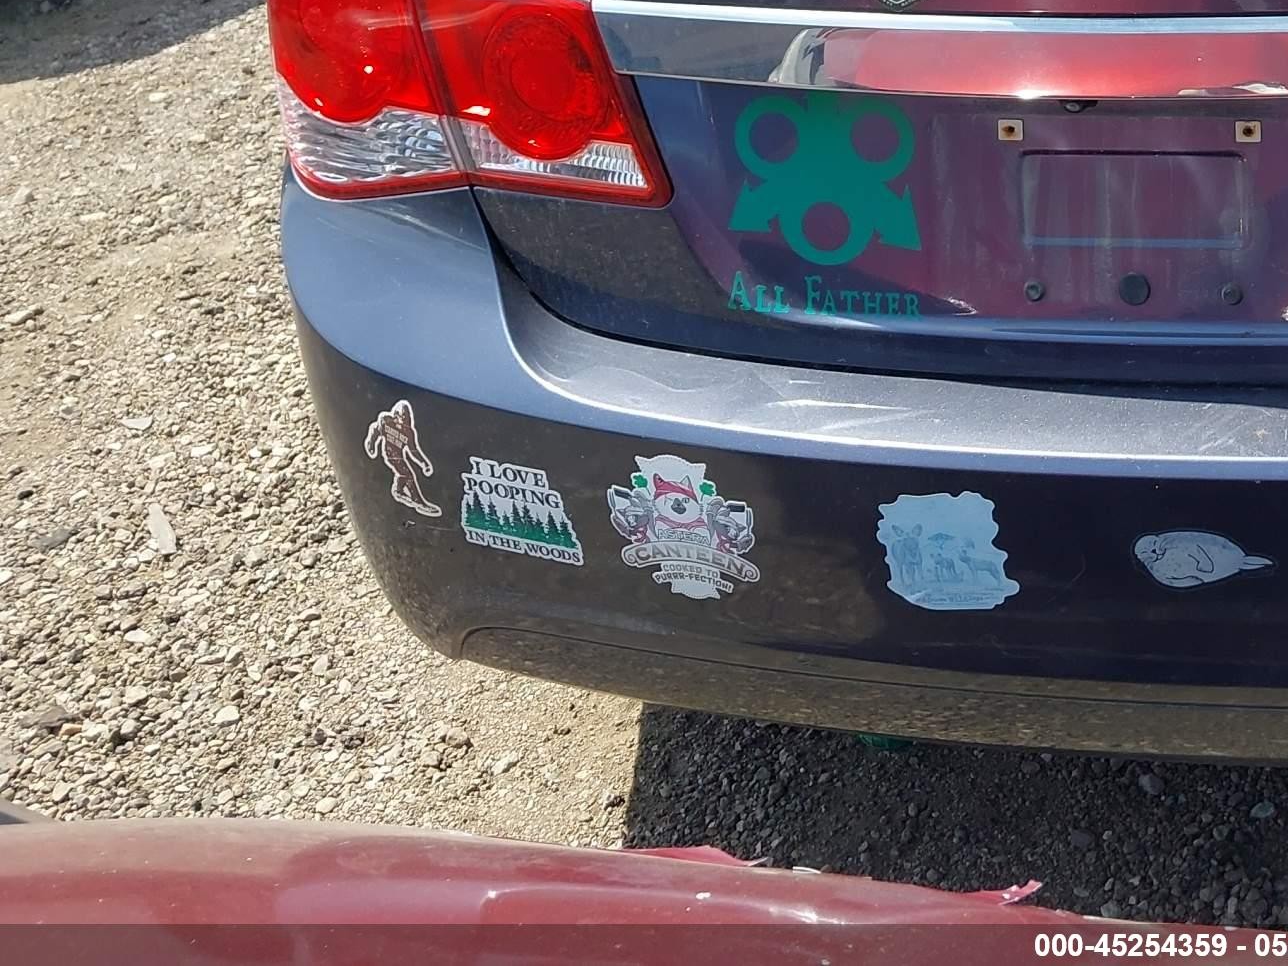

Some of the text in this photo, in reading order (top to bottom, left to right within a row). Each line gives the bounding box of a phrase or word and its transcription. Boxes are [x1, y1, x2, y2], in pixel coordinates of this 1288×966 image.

[473, 461, 546, 488] I LOVE
[465, 476, 561, 508] POOPING
[468, 530, 580, 563] IN THE WOODS
[635, 543, 746, 577] CANTEEN
[662, 564, 719, 579] COOKED TO
